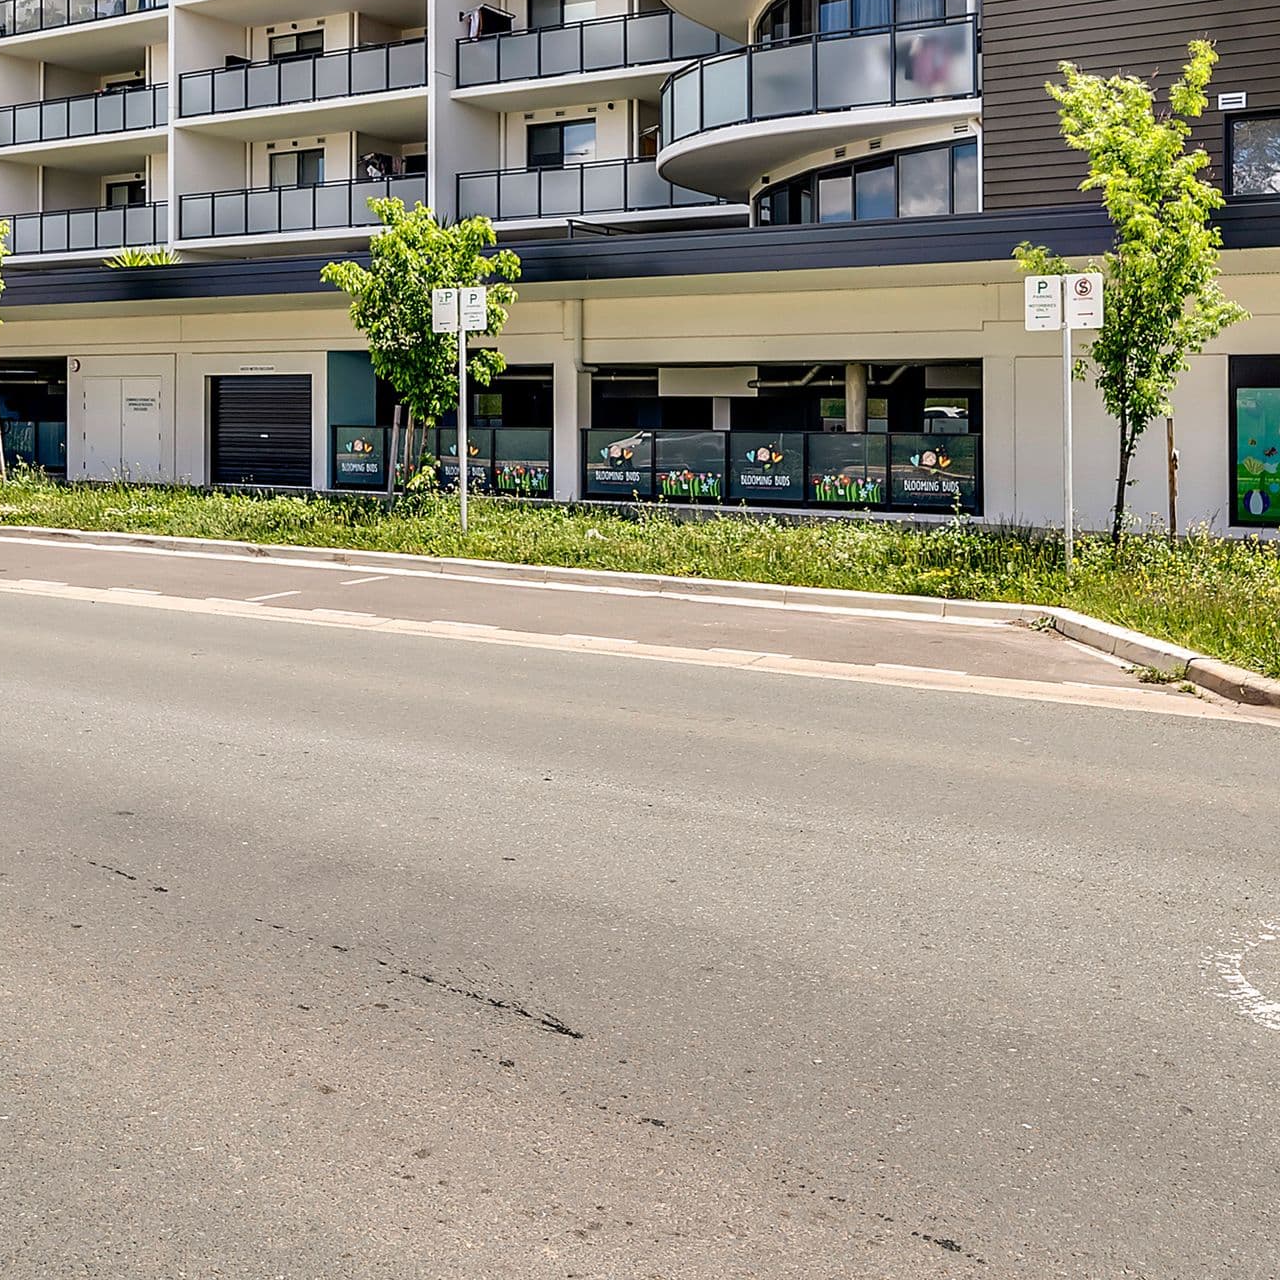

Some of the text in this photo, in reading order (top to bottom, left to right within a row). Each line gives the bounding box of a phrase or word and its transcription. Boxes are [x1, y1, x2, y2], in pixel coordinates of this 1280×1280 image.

[1037, 280, 1049, 294] P
[469, 293, 478, 305] P
[595, 470, 640, 482] BLOOMING BUDS
[740, 474, 791, 487] BLOOMING BUDS
[903, 479, 959, 493] BLOOMING BUDS
